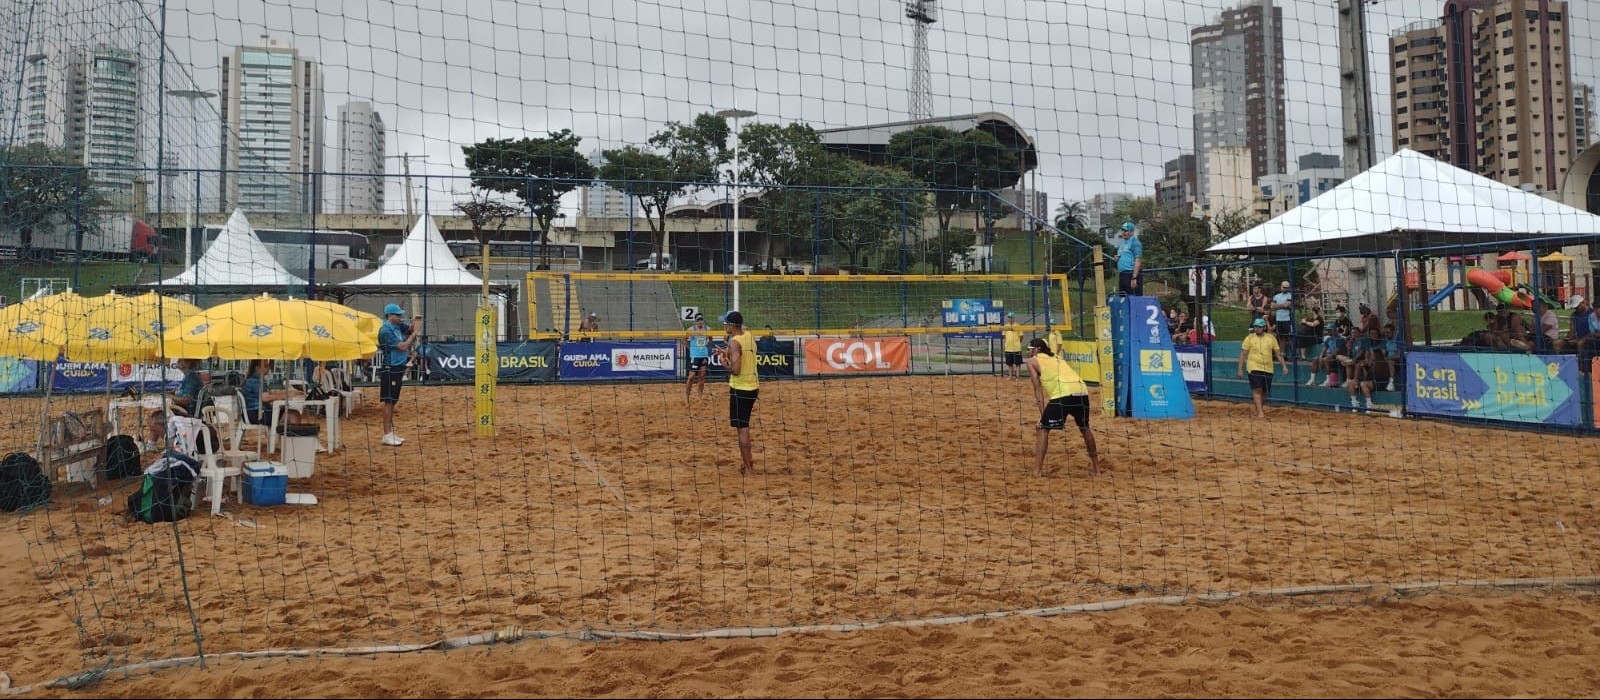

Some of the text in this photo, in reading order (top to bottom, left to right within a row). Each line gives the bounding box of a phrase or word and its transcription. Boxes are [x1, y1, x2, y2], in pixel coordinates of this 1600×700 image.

[685, 308, 695, 320] 2
[1146, 305, 1160, 325] 2
[438, 354, 476, 369] VÔLE
[501, 356, 548, 368] BRASIL
[563, 354, 588, 362] QUEM
[633, 352, 671, 361] MARINGÁ
[756, 355, 788, 366] RASIL
[826, 342, 891, 370] GOL
[1178, 359, 1201, 369] RINGÁ
[1416, 382, 1459, 400] brasil
